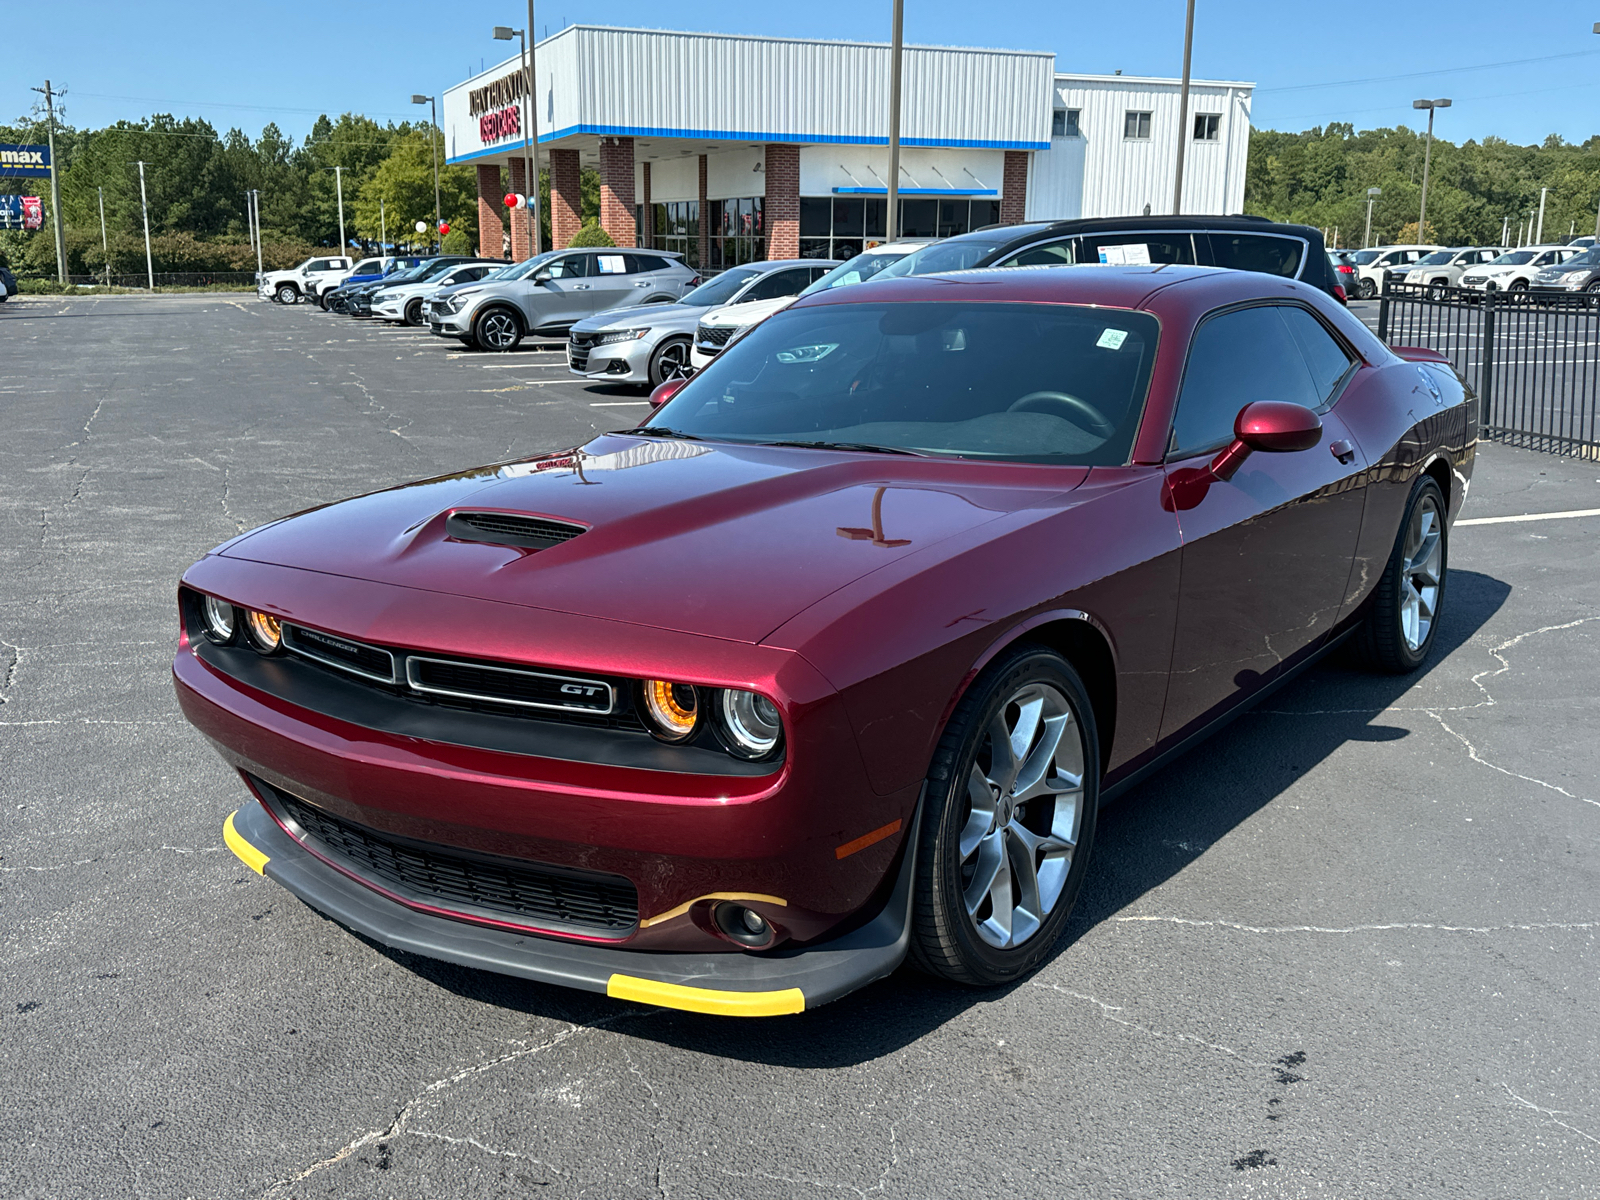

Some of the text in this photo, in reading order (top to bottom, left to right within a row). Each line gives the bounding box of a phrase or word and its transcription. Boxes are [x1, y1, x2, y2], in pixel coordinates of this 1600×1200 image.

[480, 105, 519, 142] USED CARS
[300, 630, 359, 653] CHALLENGER
[560, 683, 604, 696] GT
